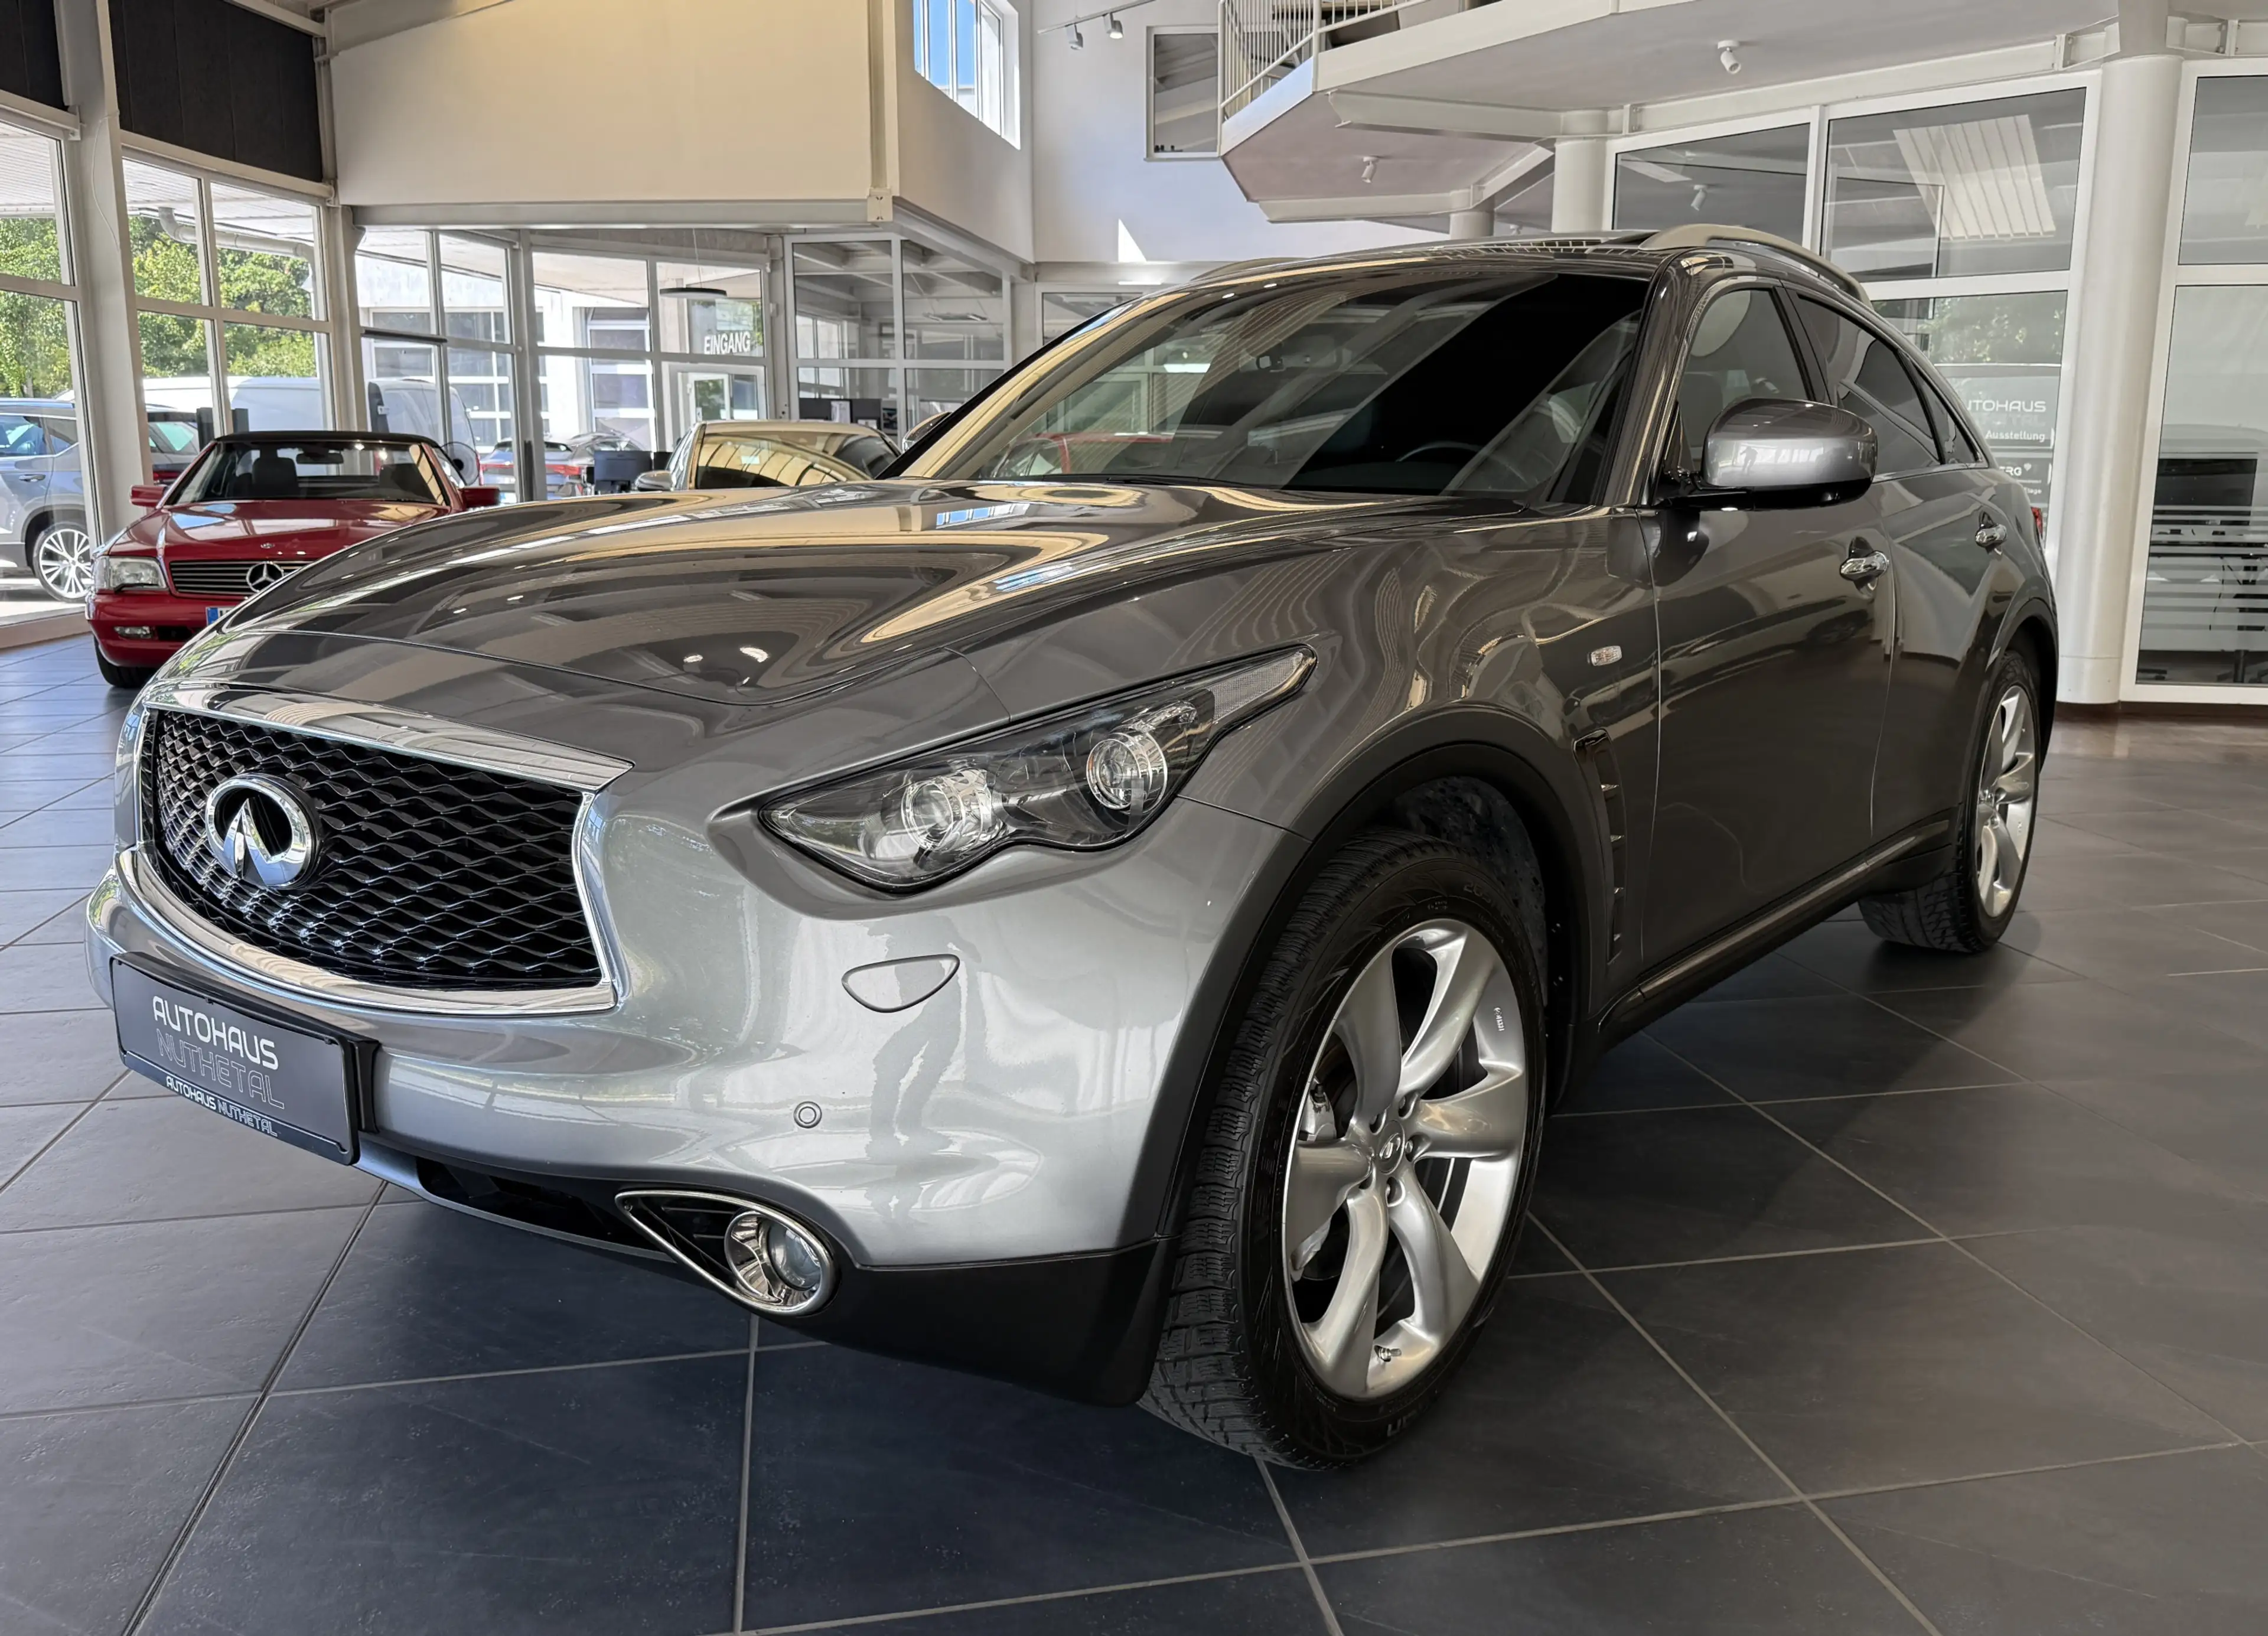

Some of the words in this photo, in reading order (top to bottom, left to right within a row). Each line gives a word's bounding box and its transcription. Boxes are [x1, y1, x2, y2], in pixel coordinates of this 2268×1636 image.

[705, 331, 750, 354] EINGANG
[1967, 400, 2046, 412] TOHAUS
[1985, 429, 2045, 442] Ausstellung
[152, 996, 279, 1070] AUTOHAUS
[156, 1028, 285, 1109] NUTHETAL
[166, 1076, 217, 1110] AUTOHAUS
[217, 1099, 278, 1137] NUTHETAL
